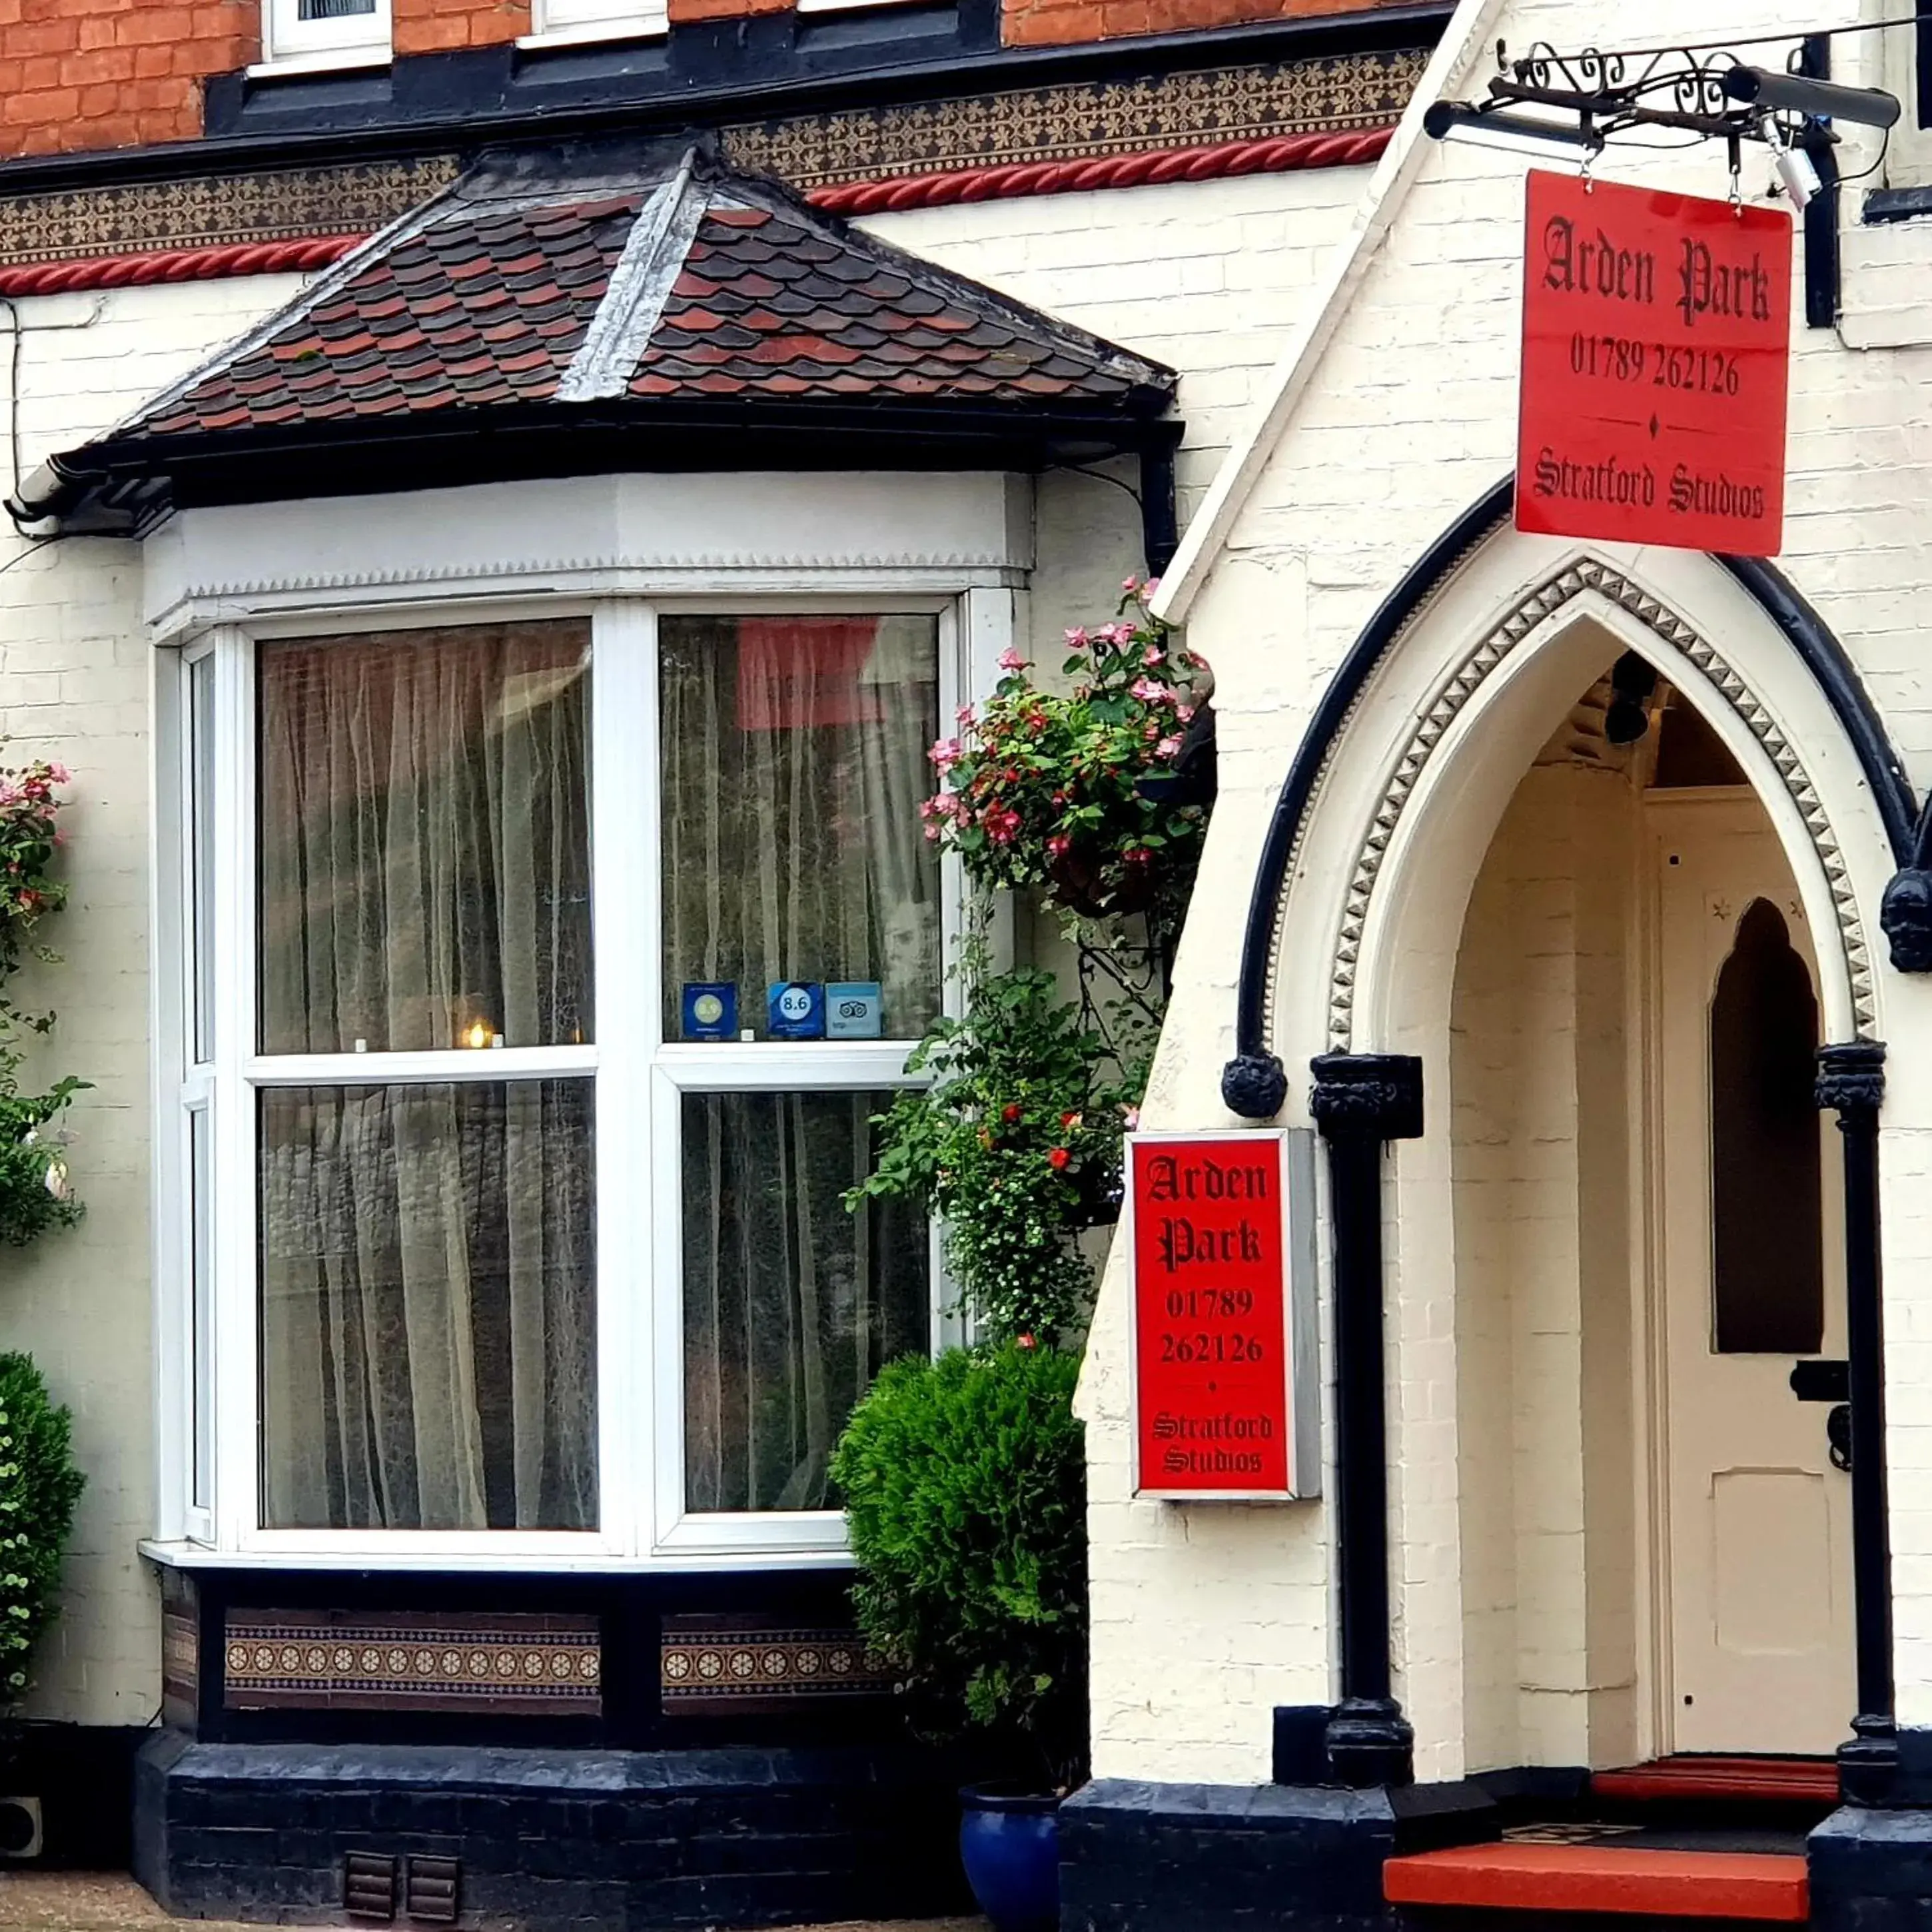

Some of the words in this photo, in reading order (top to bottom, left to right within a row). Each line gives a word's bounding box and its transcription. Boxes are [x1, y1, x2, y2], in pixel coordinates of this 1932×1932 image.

[1543, 215, 1655, 303] Arden
[1676, 237, 1769, 326] Park
[1571, 332, 1644, 381] 01789
[1652, 344, 1739, 396] 262126
[1534, 447, 1655, 507] Stratford
[1669, 463, 1763, 519] Studios
[783, 996, 807, 1011] 8.6
[1148, 1156, 1266, 1201] Arden
[1159, 1218, 1261, 1272] Park
[1167, 1288, 1252, 1318] 01789
[1161, 1334, 1262, 1362] 262126
[1154, 1412, 1272, 1439] Stratford
[1163, 1446, 1262, 1473] Studios
